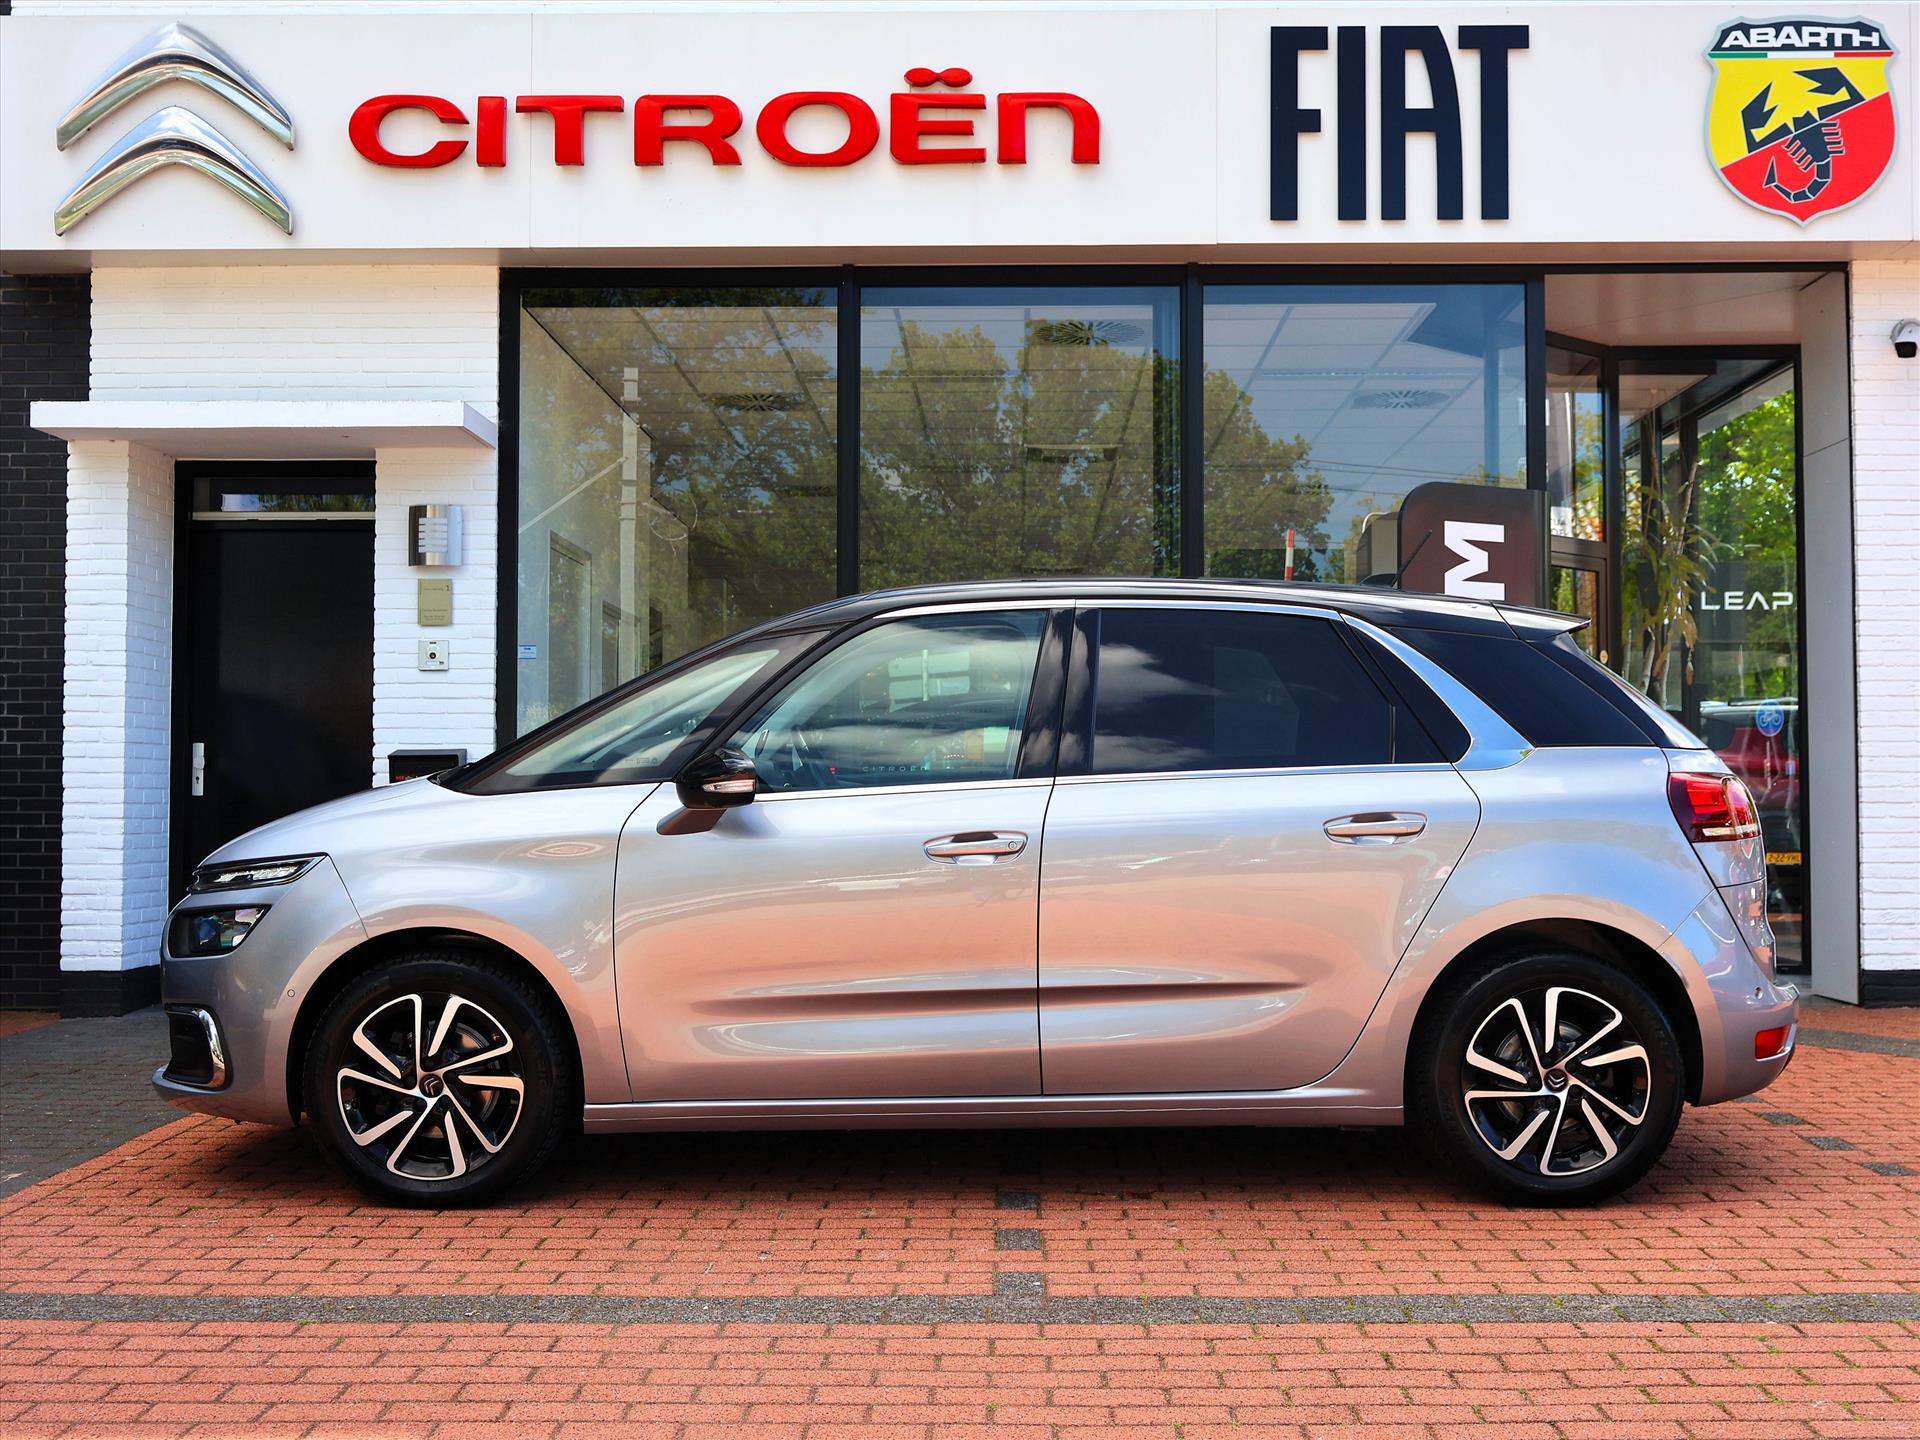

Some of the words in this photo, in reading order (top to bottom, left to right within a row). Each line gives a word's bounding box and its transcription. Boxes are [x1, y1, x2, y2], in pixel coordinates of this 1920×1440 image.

[1721, 26, 1880, 48] ABARTH
[349, 67, 1100, 167] CITROËN
[1270, 25, 1530, 221] FIAT
[1701, 591, 1794, 610] LEAP
